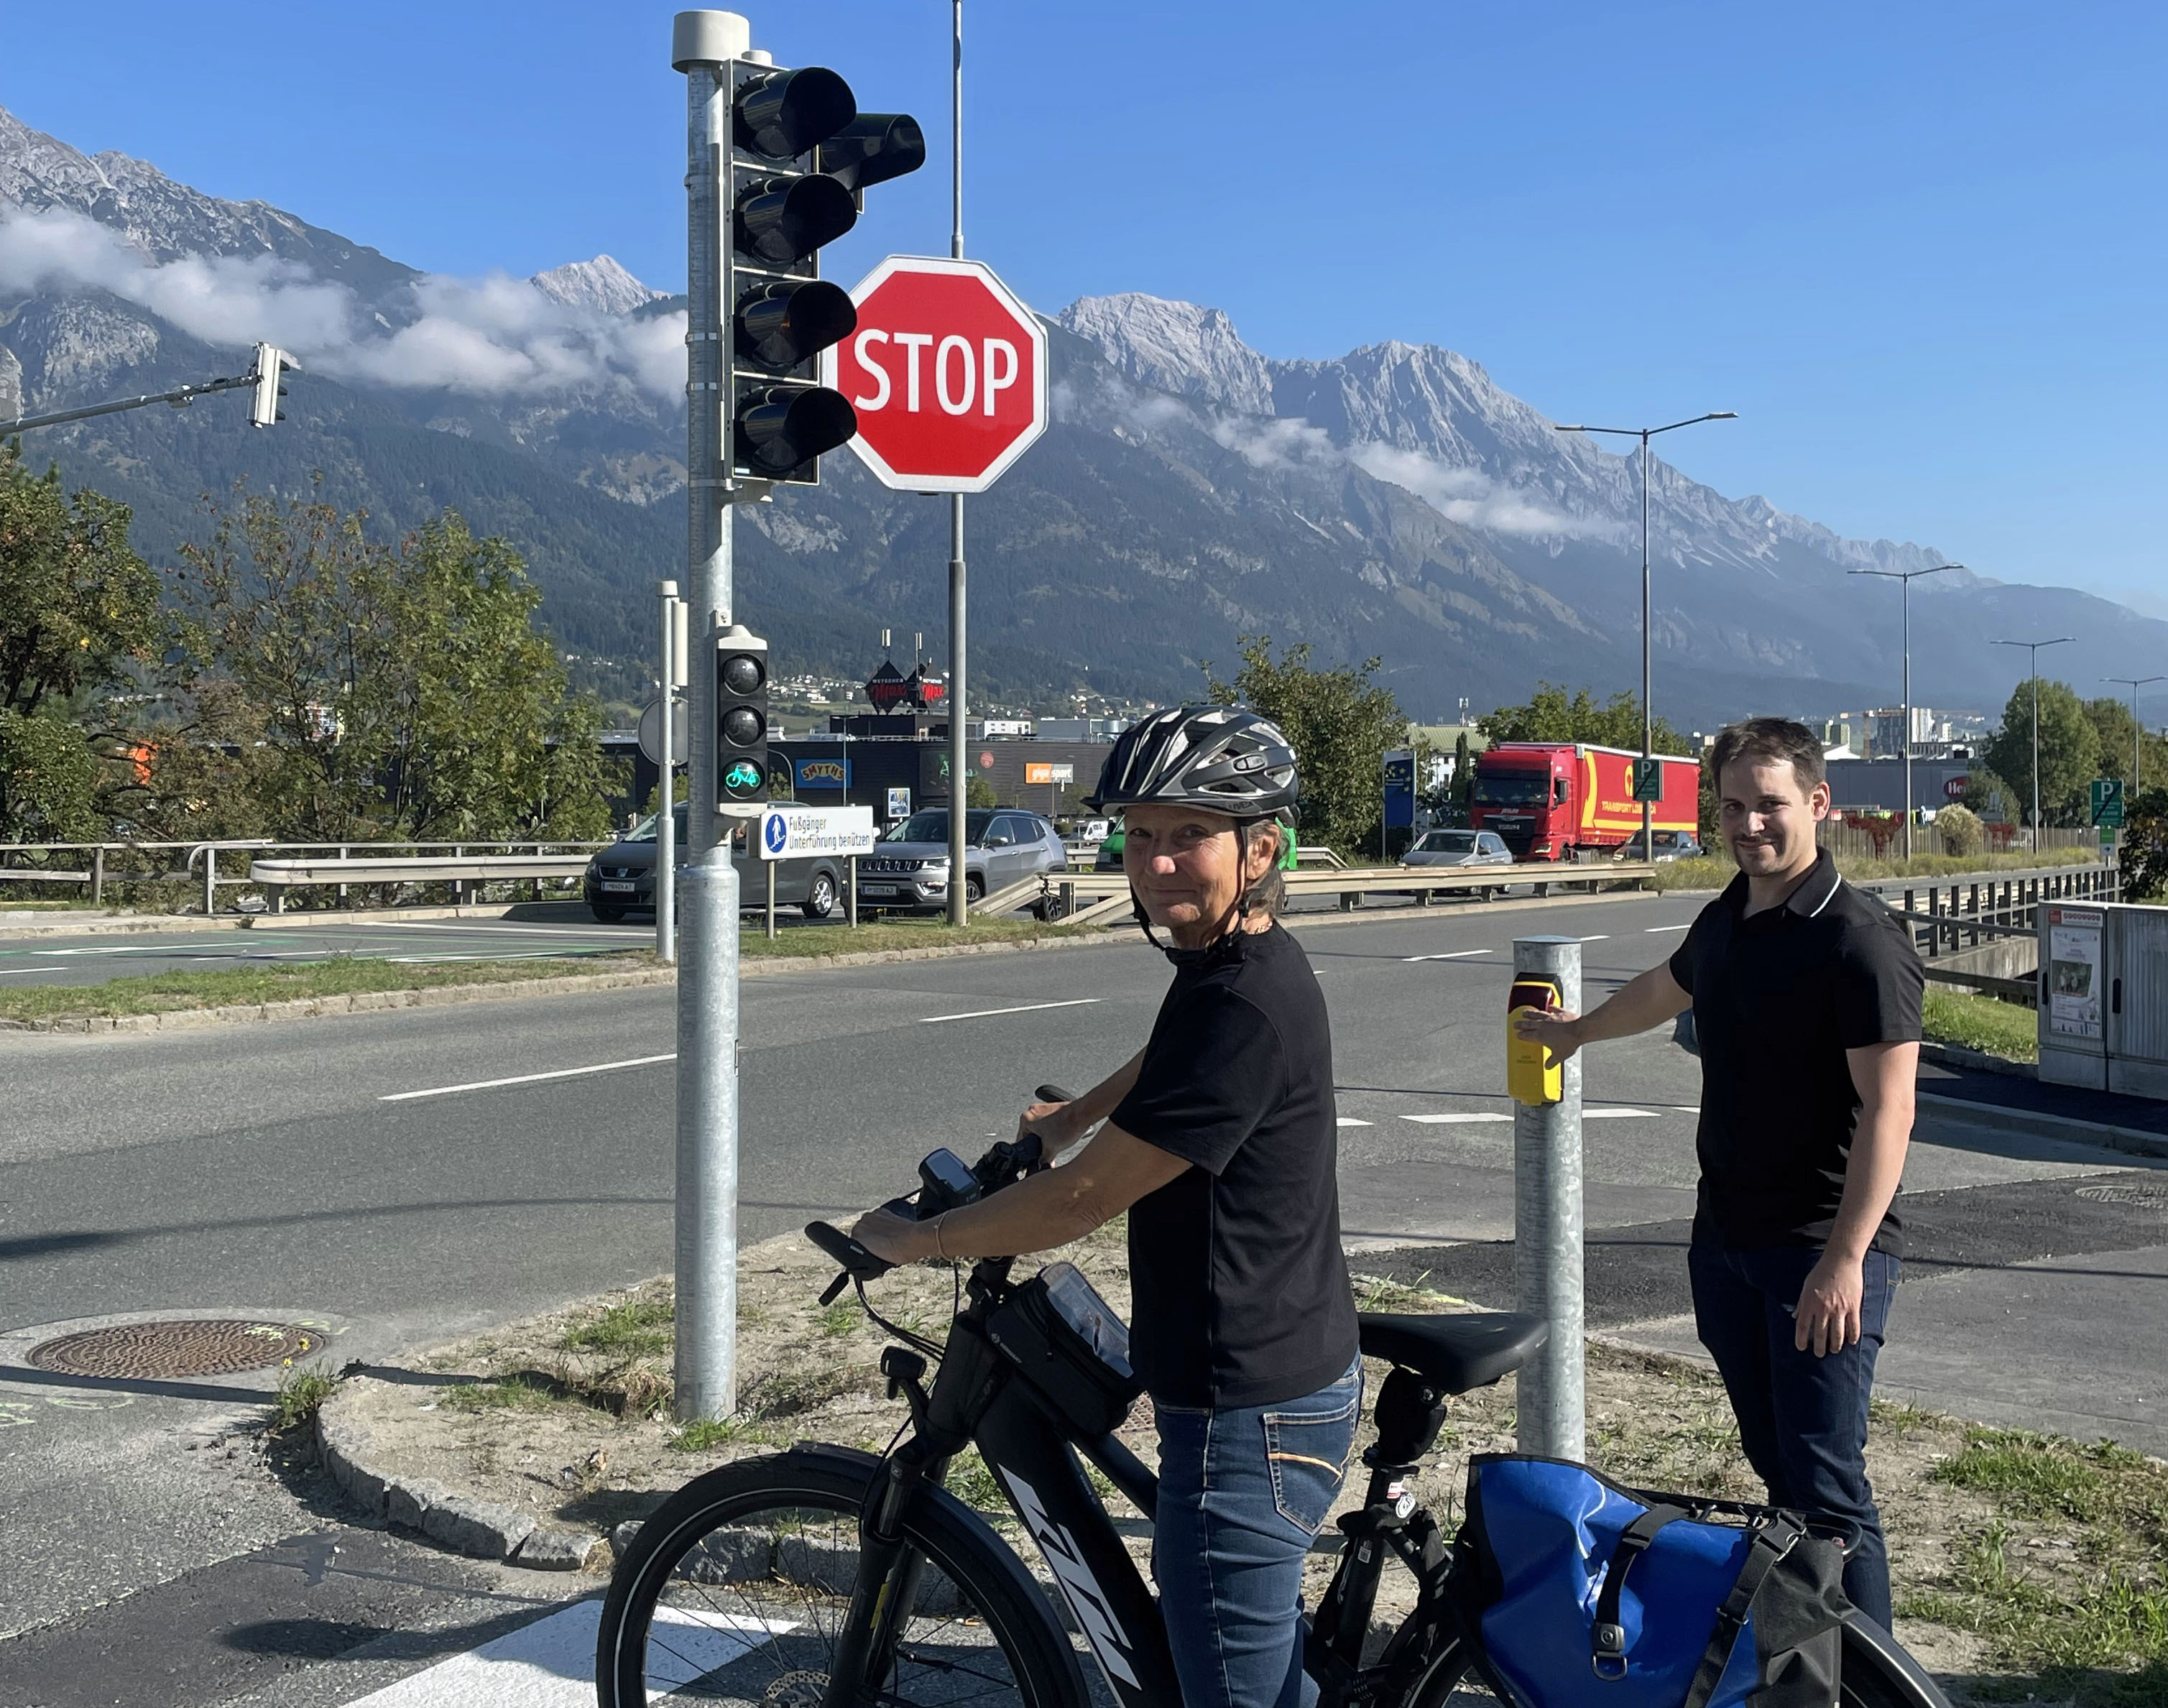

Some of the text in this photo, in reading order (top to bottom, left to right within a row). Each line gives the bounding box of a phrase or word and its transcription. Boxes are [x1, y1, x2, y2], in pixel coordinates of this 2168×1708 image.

[854, 328, 1018, 417] STOP
[802, 765, 844, 780] SMYTHS
[1641, 761, 1652, 778] P
[2100, 782, 2113, 801] P
[1602, 800, 1632, 813] TRANSPORT
[789, 816, 827, 834] Fußgänger
[789, 832, 870, 851] Unterführung benützen
